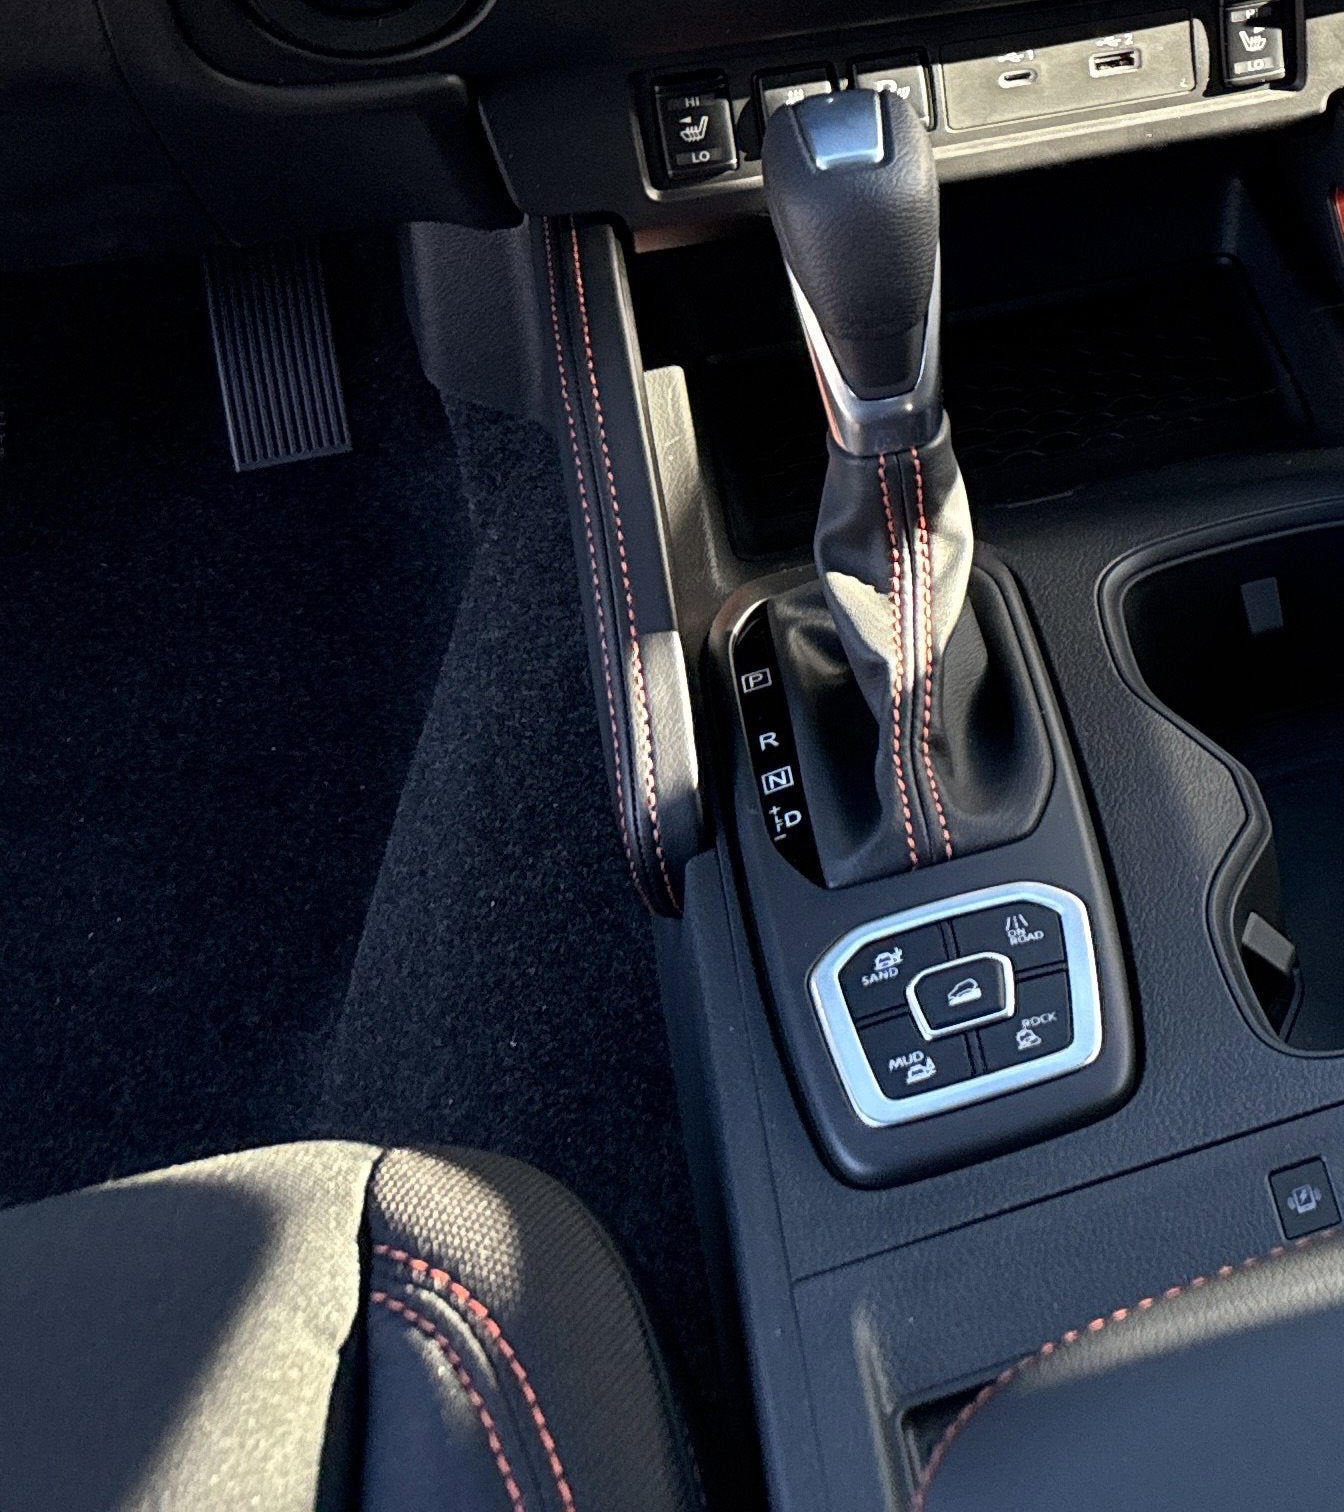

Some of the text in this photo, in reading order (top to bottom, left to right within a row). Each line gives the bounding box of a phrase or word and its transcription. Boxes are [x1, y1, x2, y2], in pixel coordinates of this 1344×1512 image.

[1248, 59, 1265, 71] LO
[685, 97, 700, 108] HI
[692, 149, 711, 163] LO
[749, 674, 763, 688] P
[759, 731, 780, 752] R
[768, 770, 787, 790] N
[783, 810, 802, 828] D
[1007, 928, 1026, 938] ON
[1010, 930, 1044, 946] ROAD
[861, 966, 899, 988] SAND
[1021, 1011, 1057, 1030] ROCK
[888, 1050, 925, 1073] MUD
